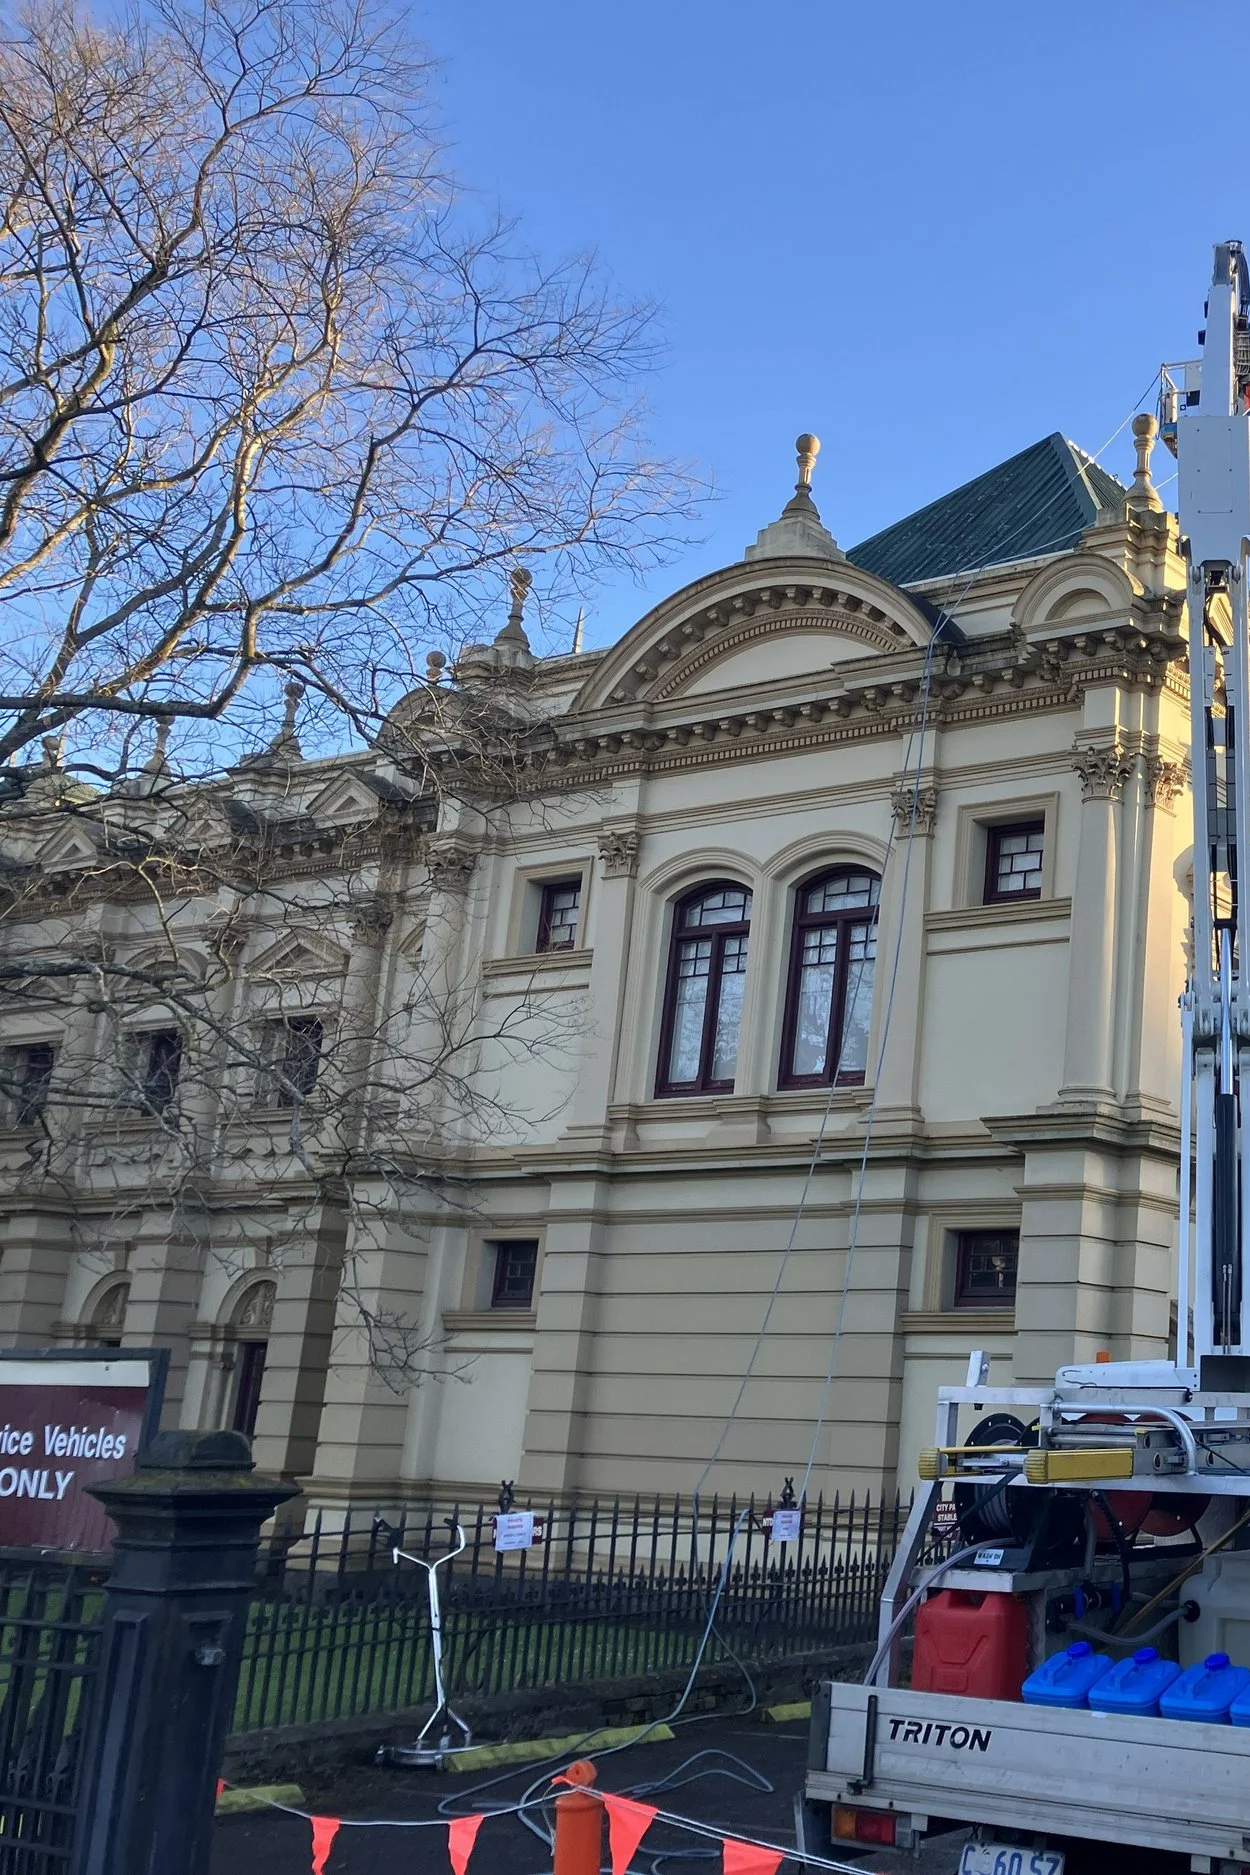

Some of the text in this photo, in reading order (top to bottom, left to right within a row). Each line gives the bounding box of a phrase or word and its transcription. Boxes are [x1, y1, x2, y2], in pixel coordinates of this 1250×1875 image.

[0, 1423, 127, 1460] ice Vehicles
[0, 1466, 75, 1500] ONLY
[889, 1719, 992, 1752] TRITON
